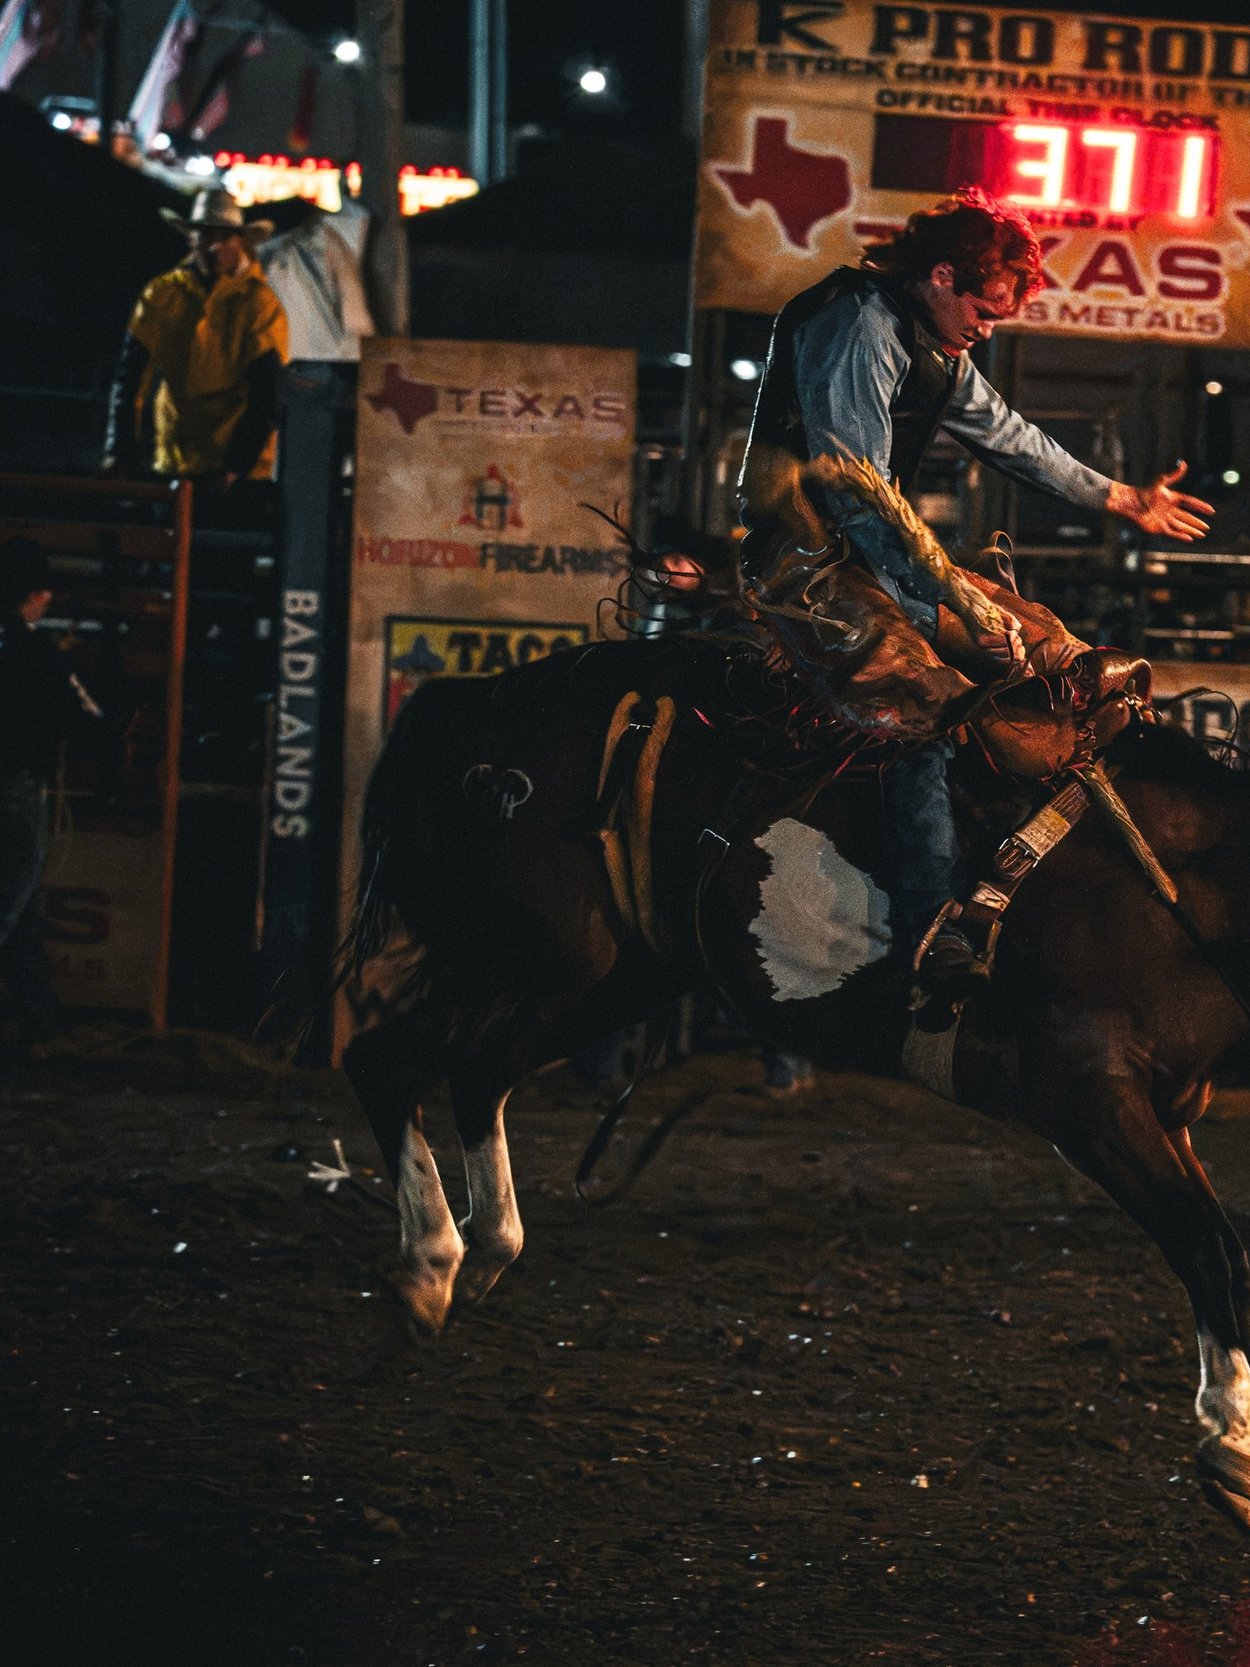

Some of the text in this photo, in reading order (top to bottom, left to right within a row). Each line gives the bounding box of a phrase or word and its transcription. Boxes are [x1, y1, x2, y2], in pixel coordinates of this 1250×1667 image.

[869, 6, 1053, 65] PRO
[896, 61, 1145, 100] CONTRACTOR
[875, 88, 1016, 118] OFFICIAL
[1058, 301, 1221, 333] METALS
[445, 386, 628, 424] TEXAS
[271, 589, 320, 841] BADLANDS
